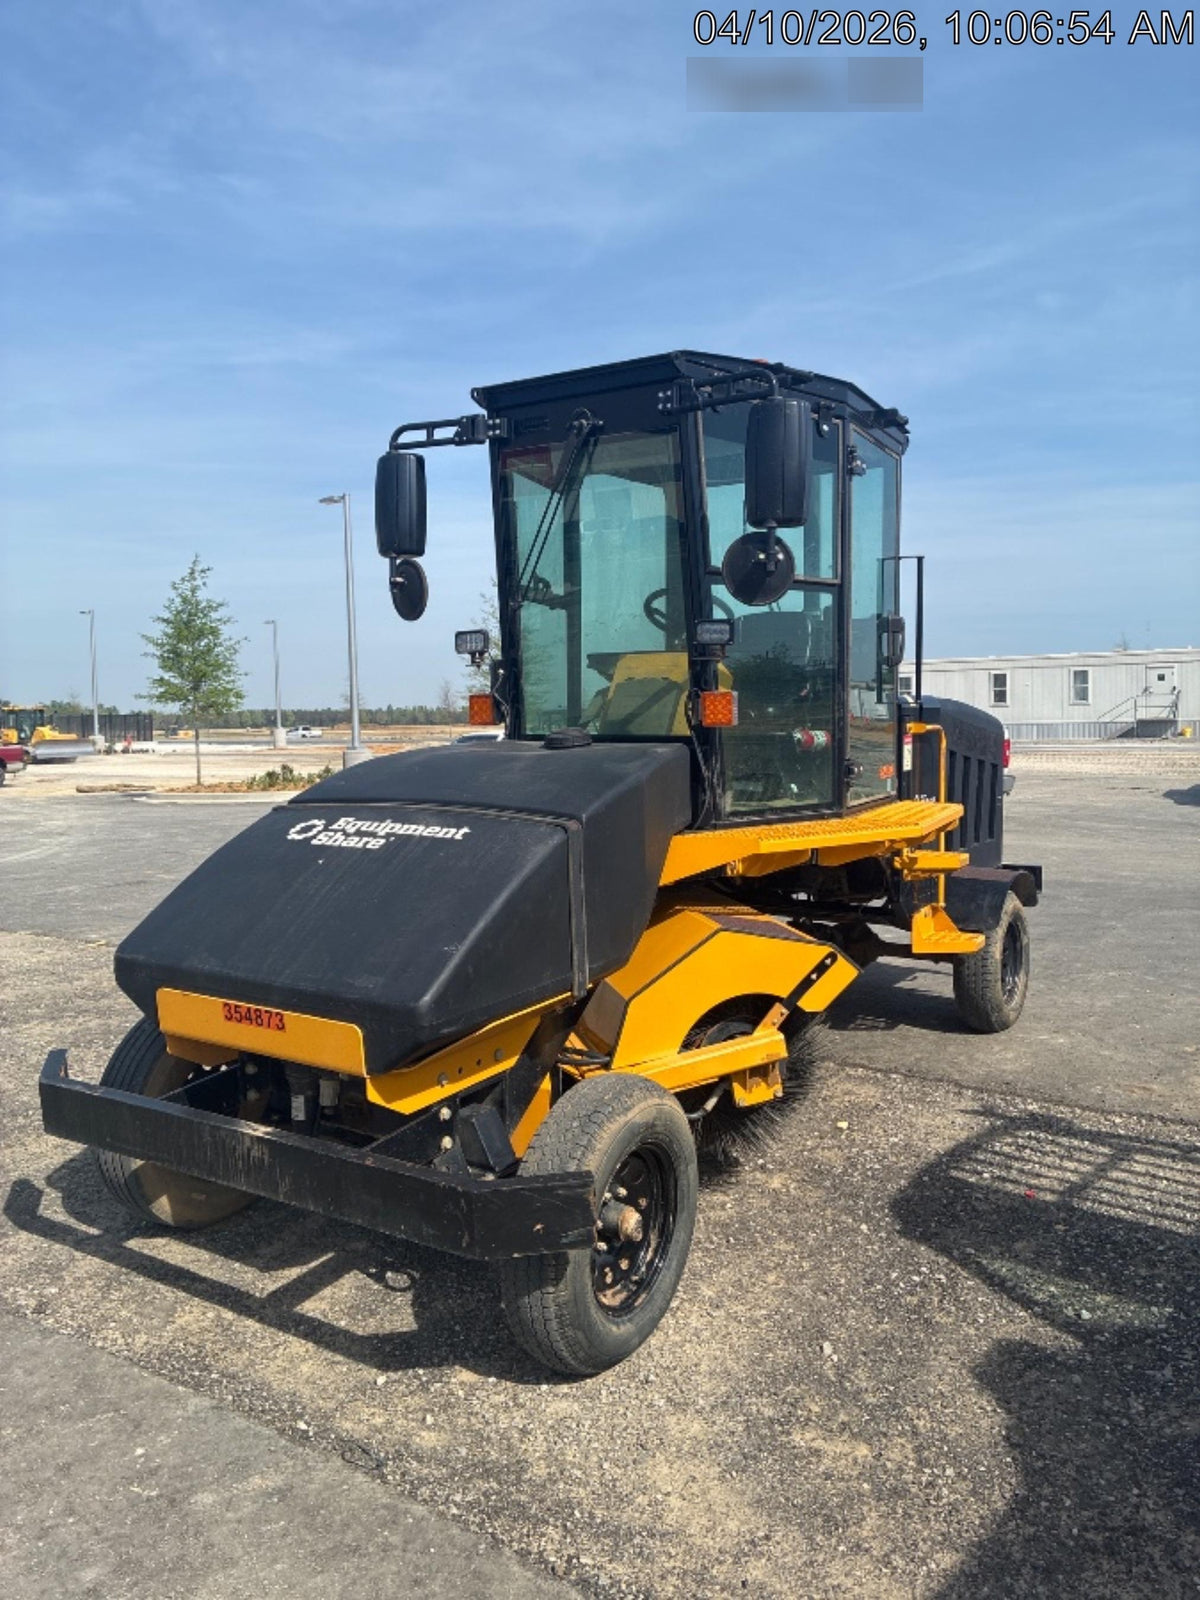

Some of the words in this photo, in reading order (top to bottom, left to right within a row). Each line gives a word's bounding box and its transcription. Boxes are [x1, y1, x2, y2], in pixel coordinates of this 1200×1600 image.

[310, 831, 388, 849] Share
[328, 817, 472, 840] Equipment
[223, 1002, 286, 1031] 354873
